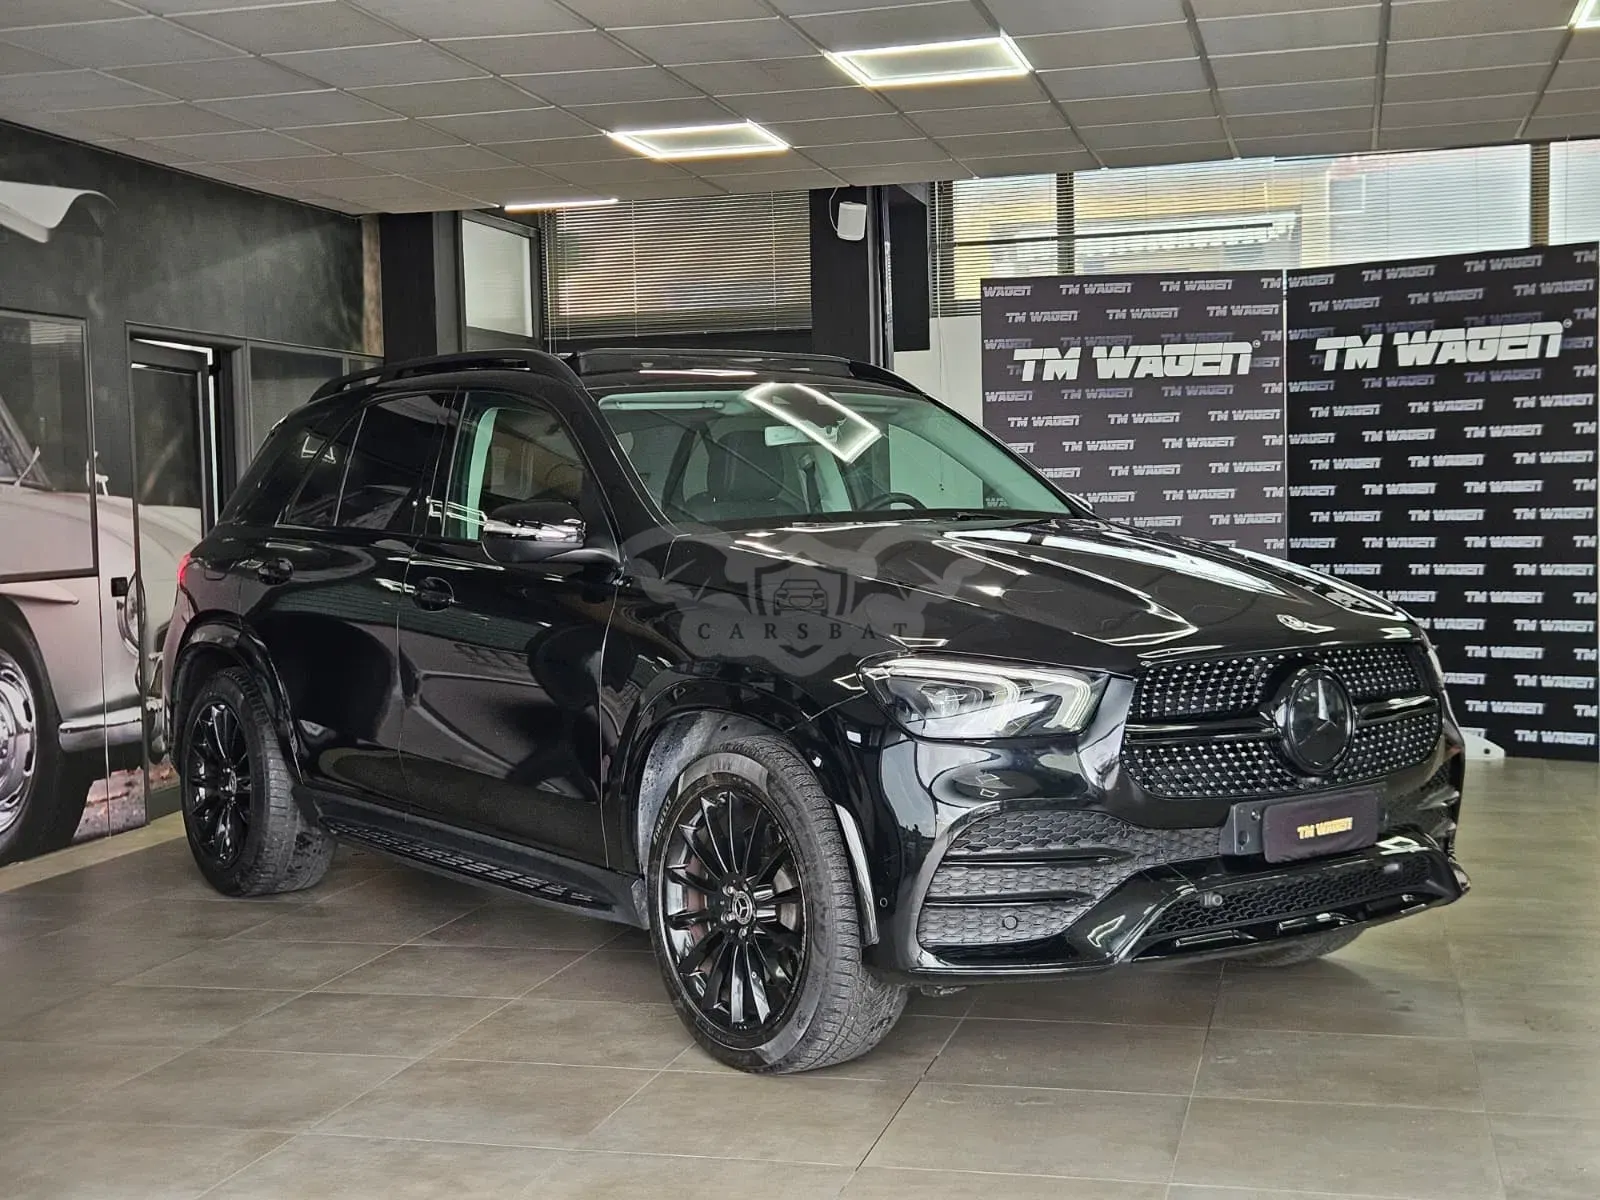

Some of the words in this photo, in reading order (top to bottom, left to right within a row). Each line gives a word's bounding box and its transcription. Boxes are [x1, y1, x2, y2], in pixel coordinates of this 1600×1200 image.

[1574, 250, 1598, 263] TM
[1464, 260, 1486, 272] TM
[1489, 255, 1542, 270] WAGEN
[1362, 270, 1382, 281] TM
[1385, 265, 1435, 279] WAGEN
[1160, 281, 1180, 291] TM
[1184, 280, 1232, 290] WAGEN
[1261, 278, 1281, 288] TM
[1286, 274, 1335, 287] WAGEN
[983, 286, 1031, 296] WAGEN
[1060, 284, 1080, 295] TM
[1083, 283, 1132, 294] WAGEN
[1513, 284, 1536, 296] TM
[1540, 279, 1595, 293] WAGEN
[1408, 293, 1429, 304] TM
[1432, 288, 1483, 302] WAGEN
[1207, 306, 1227, 316] TM
[1231, 304, 1279, 315] WAGEN
[1309, 301, 1329, 312] TM
[1332, 297, 1380, 310] WAGEN
[1006, 312, 1026, 322] TM
[1030, 311, 1078, 322] WAGEN
[1106, 309, 1127, 319] TM
[1130, 308, 1179, 318] WAGEN
[1463, 316, 1486, 326] TM
[1489, 312, 1542, 323] WAGEN
[1574, 308, 1597, 319] TM
[1362, 323, 1383, 334] TM
[1386, 320, 1434, 331] WAGEN
[1262, 330, 1282, 341] TM
[1289, 328, 1334, 340] WAGEN
[984, 338, 1031, 349] WAGEN
[1061, 336, 1081, 347] TM
[1085, 335, 1132, 346] WAGEN
[1315, 334, 1383, 371] TM
[1013, 347, 1081, 381] TM
[1464, 372, 1485, 383] TM
[1490, 369, 1541, 381] WAGEN
[1573, 365, 1597, 377] TM
[1288, 381, 1334, 392] WAGEN
[1362, 378, 1382, 388] TM
[1386, 375, 1435, 387] WAGEN
[1061, 389, 1081, 399] TM
[1085, 388, 1133, 398] WAGEN
[1162, 386, 1182, 396] TM
[1185, 385, 1234, 395] WAGEN
[1262, 383, 1283, 393] TM
[985, 391, 1032, 401] WAGEN
[1513, 396, 1536, 408] TM
[1539, 394, 1594, 407] WAGEN
[1310, 407, 1329, 417] TM
[1333, 404, 1380, 416] WAGEN
[1408, 402, 1429, 413] TM
[1432, 399, 1484, 412] WAGEN
[1008, 417, 1028, 427] TM
[1032, 415, 1079, 426] WAGEN
[1108, 414, 1128, 424] TM
[1132, 412, 1180, 423] WAGEN
[1208, 411, 1229, 421] TM
[1232, 409, 1281, 420] WAGEN
[1464, 427, 1486, 438] TM
[1489, 424, 1542, 437] WAGEN
[1573, 422, 1596, 434] TM
[1263, 435, 1283, 445] TM
[1289, 433, 1335, 444] WAGEN
[1362, 431, 1383, 442] TM
[1386, 429, 1436, 441] WAGEN
[1062, 441, 1082, 451] TM
[1086, 440, 1134, 450] WAGEN
[1162, 438, 1183, 448] TM
[1186, 437, 1235, 447] WAGEN
[1408, 456, 1430, 467] TM
[1432, 454, 1484, 466] WAGEN
[1513, 453, 1536, 464] TM
[1539, 451, 1594, 463] WAGEN
[1109, 466, 1129, 476] TM
[1133, 464, 1180, 475] WAGEN
[1209, 463, 1229, 473] TM
[1233, 461, 1282, 472] WAGEN
[1310, 459, 1330, 470] TM
[1333, 458, 1381, 469] WAGEN
[1362, 484, 1383, 495] TM
[1386, 483, 1436, 494] WAGEN
[1464, 482, 1487, 493] TM
[1489, 480, 1543, 492] WAGEN
[1573, 479, 1596, 490] TM
[1086, 492, 1137, 502] WAGEN
[1163, 490, 1184, 500] TM
[1187, 489, 1235, 499] WAGEN
[1263, 487, 1284, 497] TM
[1289, 486, 1336, 496] WAGEN
[1210, 515, 1230, 525] TM
[1233, 513, 1283, 524] WAGEN
[1310, 512, 1330, 522] TM
[1333, 511, 1381, 522] WAGEN
[1408, 510, 1430, 521] TM
[1433, 509, 1485, 521] WAGEN
[1513, 508, 1536, 519] TM
[1539, 507, 1594, 519] WAGEN
[1132, 516, 1183, 527] WAGEN
[1264, 539, 1285, 549] TM
[1289, 538, 1336, 548] WAGEN
[1362, 537, 1383, 548] TM
[1386, 537, 1436, 548] WAGEN
[1464, 537, 1487, 547] TM
[1489, 536, 1543, 547] WAGEN
[1573, 536, 1597, 547] TM
[1332, 564, 1381, 574] WAGEN
[1409, 564, 1430, 575] TM
[1433, 564, 1485, 575] WAGEN
[1513, 564, 1537, 575] TM
[1540, 564, 1594, 575] WAGEN
[1385, 591, 1436, 602] WAGEN
[1464, 591, 1487, 602] TM
[1489, 592, 1544, 603] WAGEN
[1573, 592, 1597, 604] TM
[1433, 618, 1485, 630] WAGEN
[1514, 619, 1537, 631] TM
[1540, 620, 1595, 632] WAGEN
[1465, 646, 1487, 657] TM
[1490, 647, 1544, 659] WAGEN
[1573, 648, 1598, 660] TM
[1514, 675, 1537, 686] TM
[1540, 676, 1596, 688] WAGEN
[1465, 700, 1488, 712] TM
[1490, 702, 1544, 714] WAGEN
[1574, 705, 1598, 716] TM
[1515, 730, 1538, 742] TM
[1541, 731, 1596, 745] WAGEN
[1297, 825, 1315, 840] TM
